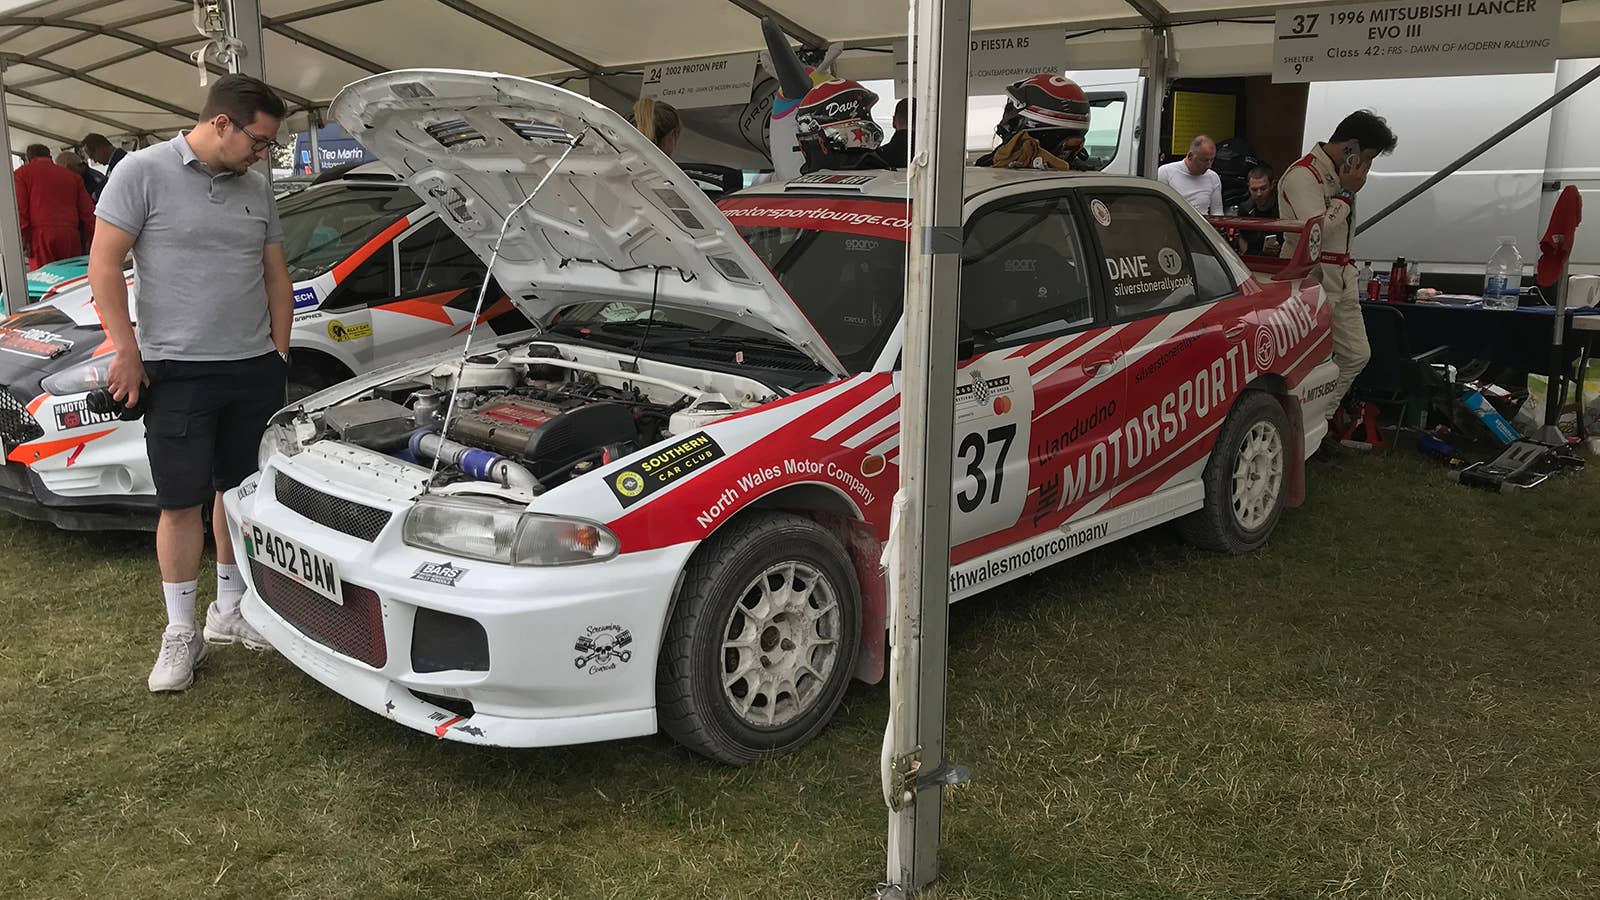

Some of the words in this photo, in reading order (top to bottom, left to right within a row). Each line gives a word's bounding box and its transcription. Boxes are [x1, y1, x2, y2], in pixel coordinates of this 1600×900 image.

[1329, 11, 1365, 25] 1996
[1369, 4, 1461, 22] MITSUBISHI
[1467, 0, 1537, 16] LANCER
[1292, 14, 1320, 34] 37
[1367, 25, 1401, 40] EVO
[1406, 24, 1421, 37] III
[981, 38, 1014, 50] FIESTA
[1016, 37, 1030, 48] R5
[1327, 47, 1359, 58] Class
[1364, 46, 1385, 56] 42:
[1387, 46, 1403, 55] FRS
[1410, 44, 1440, 54] DAWN
[1442, 43, 1455, 52] OF
[1457, 40, 1502, 51] MODERN
[1504, 38, 1551, 48] RALLYING
[650, 68, 662, 80] 24
[666, 66, 681, 75] 2002
[682, 63, 710, 74] PROTON
[711, 60, 728, 70] PERT
[1294, 64, 1302, 74] 9
[826, 100, 860, 117] Dave
[322, 149, 336, 160] Teo
[337, 147, 363, 159] Martin
[1105, 256, 1151, 280] DAVE
[1164, 254, 1176, 268] 37
[294, 292, 314, 303] ECH
[1036, 400, 1117, 467] Llandudno
[641, 435, 709, 472] SOUTHERN
[659, 466, 682, 482] CAR
[685, 450, 713, 468] CLUB
[957, 423, 1017, 513] 37
[696, 488, 740, 529] North
[736, 465, 782, 493] Wales
[783, 458, 825, 475] Motor
[827, 462, 876, 506] Company
[1033, 473, 1058, 528] THE
[252, 524, 299, 576] P402
[300, 546, 336, 595] BAW
[950, 522, 1109, 592] thwalesmotorcompany
[422, 564, 459, 578] BARS
[586, 622, 622, 637] Screaming
[427, 712, 448, 721] TOW
